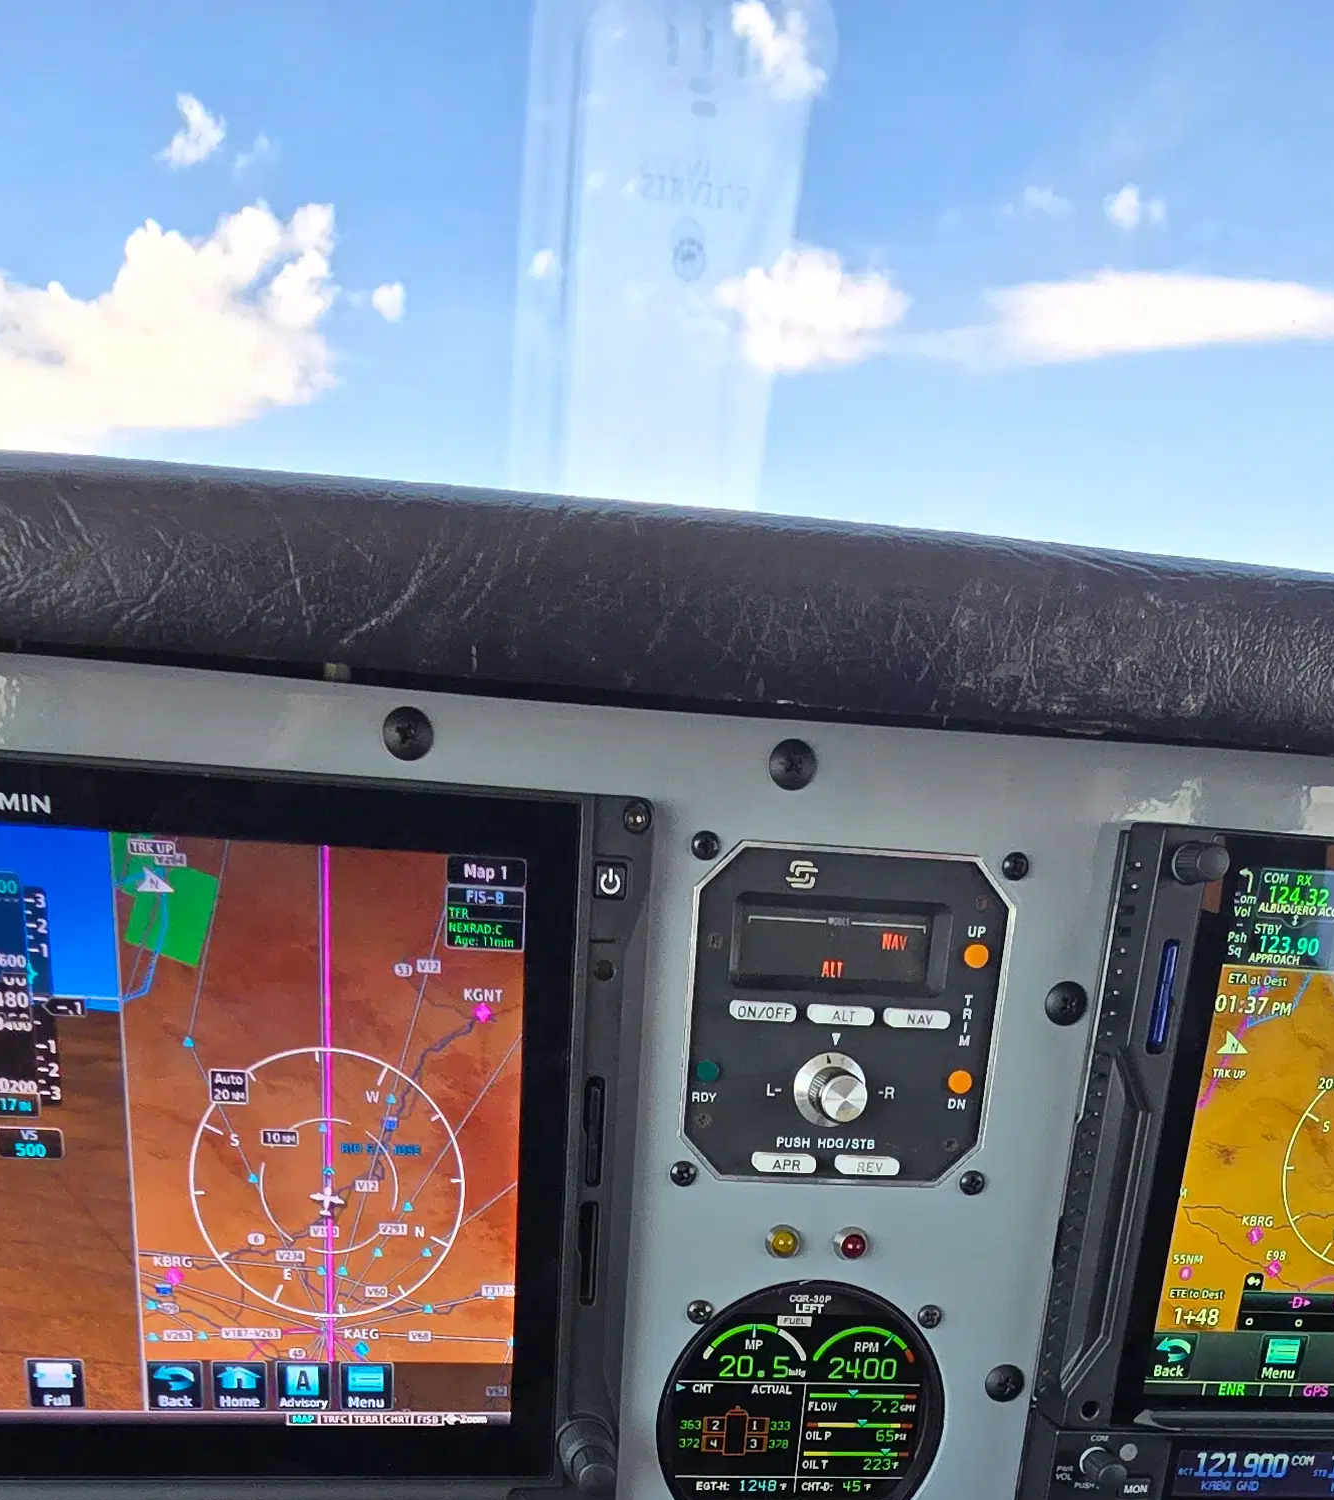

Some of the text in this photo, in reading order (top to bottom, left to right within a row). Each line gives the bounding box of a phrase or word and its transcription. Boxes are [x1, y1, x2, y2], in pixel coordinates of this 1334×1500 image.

[463, 864, 508, 881] Map 1
[465, 890, 504, 905] FIS-B
[1268, 886, 1330, 907] 124.32
[449, 923, 503, 935] NEXRAD:C
[968, 927, 986, 938] UP
[882, 934, 907, 950] NAV
[1260, 935, 1320, 956] 123.90
[1249, 953, 1300, 966] APPROACH
[821, 961, 844, 978] ALT
[463, 989, 503, 1002] KGNT
[1214, 994, 1292, 1016] 01:37 PM
[737, 1005, 791, 1019] ON/OFF
[832, 1011, 856, 1022] ALT
[907, 1014, 933, 1026] NAV
[959, 995, 973, 1047] TRIM
[692, 1092, 717, 1103] RDY
[948, 1098, 966, 1109] DN
[776, 1137, 875, 1150] PUSH HDG/STB
[772, 1158, 801, 1171] APR
[857, 1161, 884, 1173] REV
[1242, 1215, 1273, 1228] KBRG
[153, 1256, 191, 1269] KBRG
[789, 1294, 831, 1304] CGR-30P
[796, 1303, 824, 1314] LEFT
[783, 1317, 806, 1326] FUEL
[1173, 1307, 1219, 1326] 1+48
[344, 1328, 379, 1340] KAEG
[745, 1339, 763, 1350] MP
[854, 1342, 879, 1353] RPM
[719, 1355, 789, 1378] 20.5
[828, 1357, 897, 1380] 2400
[1153, 1365, 1183, 1378] Back
[1262, 1366, 1295, 1380] Menu
[692, 1384, 714, 1394] CHT
[751, 1384, 792, 1395] ACTUAL
[158, 1395, 384, 1410] Back Home Advisory Menu
[807, 1402, 837, 1411] FLOW
[1194, 1452, 1286, 1478] 121.900
[696, 1480, 861, 1492] EGT-H: 1248 CHT-D: 45
[1123, 1484, 1148, 1495] MON
